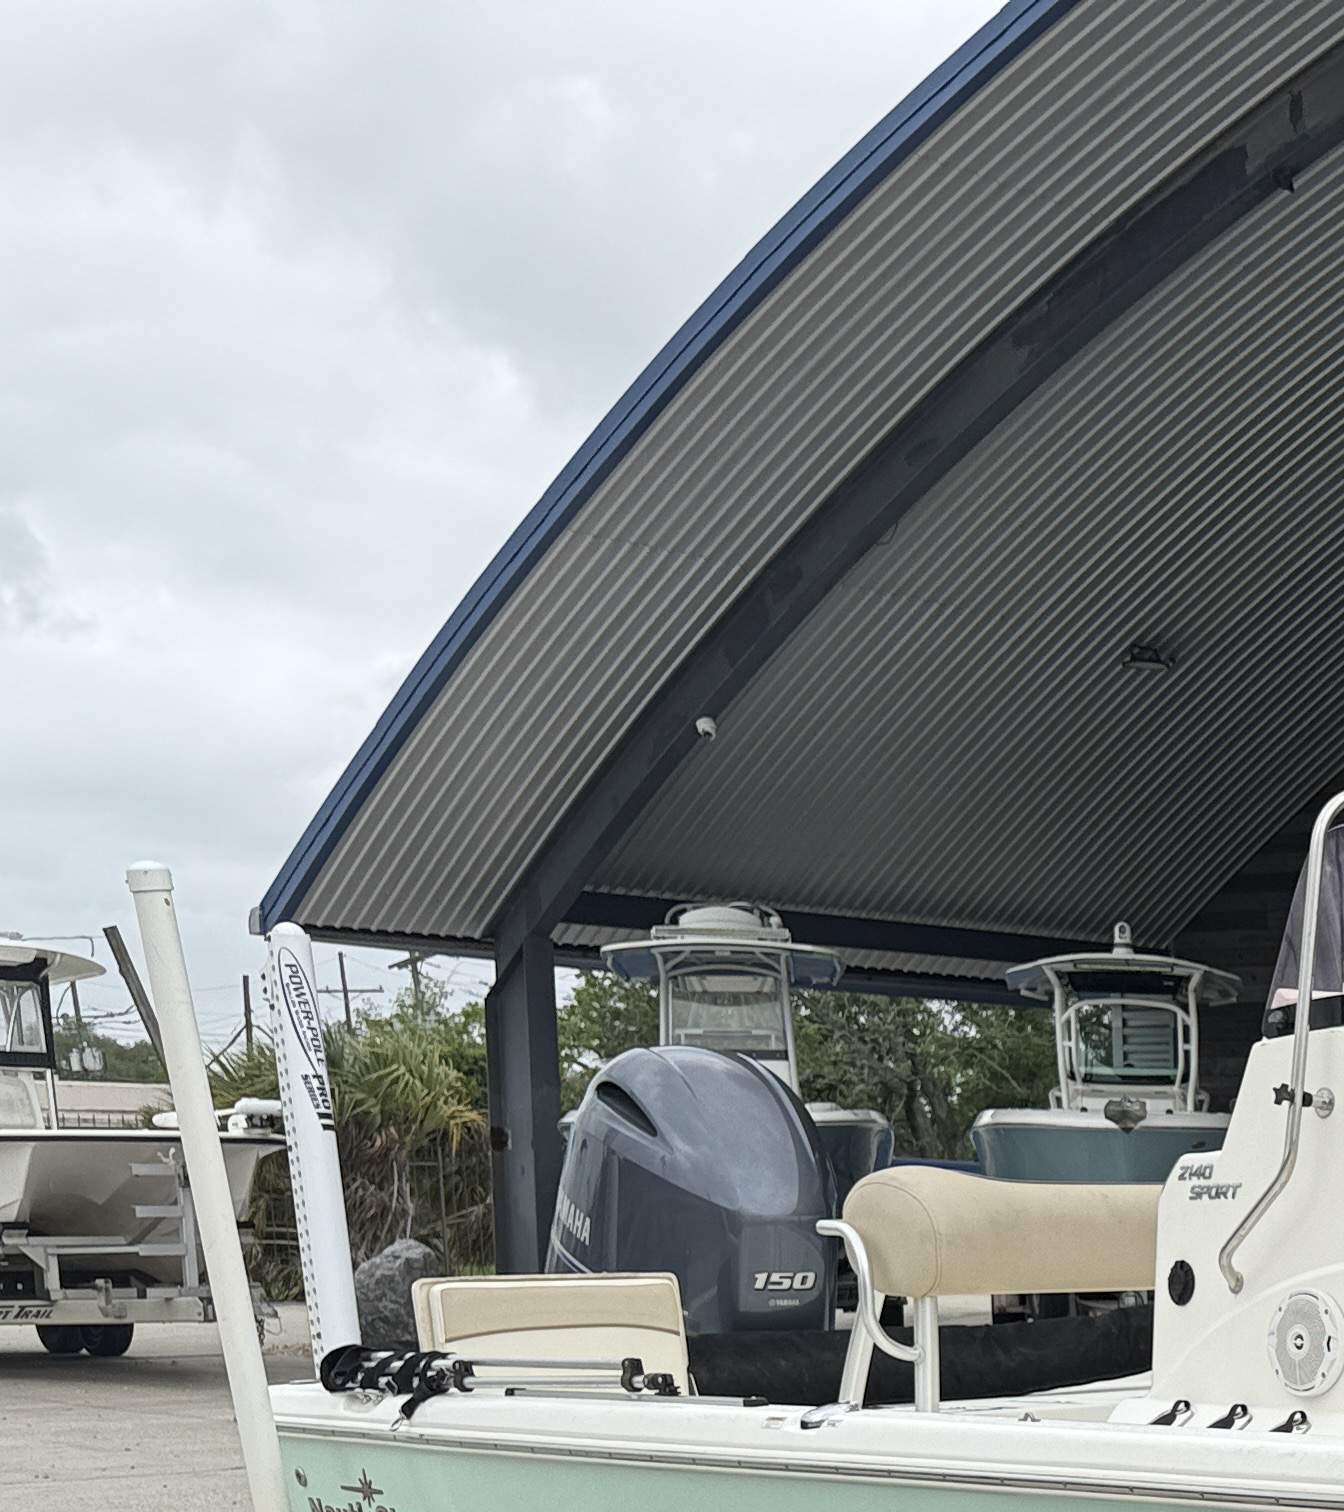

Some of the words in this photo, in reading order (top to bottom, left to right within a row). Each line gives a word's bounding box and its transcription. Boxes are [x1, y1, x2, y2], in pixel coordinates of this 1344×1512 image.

[284, 963, 325, 1068] POWER-POLE
[311, 1073, 331, 1111] PRO
[1178, 1164, 1214, 1181] 2140
[1188, 1182, 1243, 1201] SPORT
[753, 1271, 817, 1291] 150
[13, 1304, 56, 1320] TRAIL
